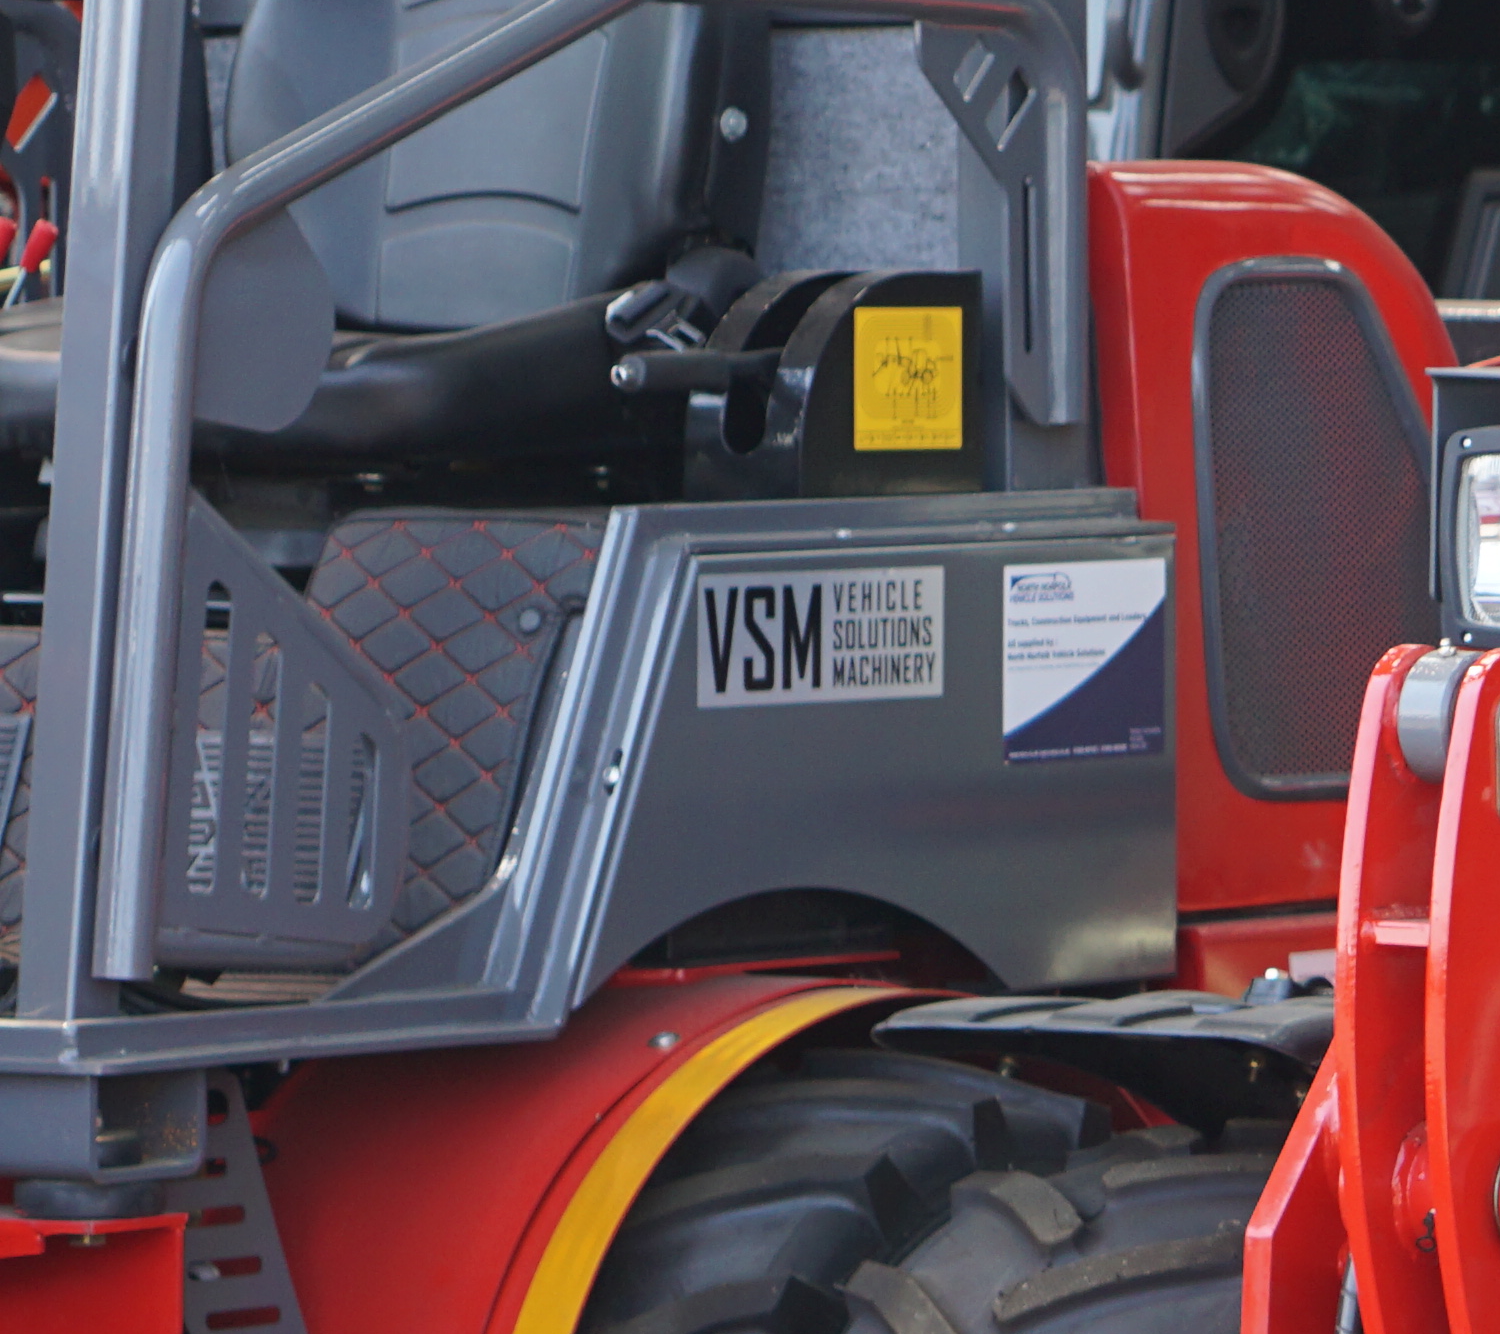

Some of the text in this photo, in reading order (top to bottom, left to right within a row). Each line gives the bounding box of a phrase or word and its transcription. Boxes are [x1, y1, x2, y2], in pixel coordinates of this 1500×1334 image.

[832, 579, 923, 612] VEHICLE
[704, 583, 823, 694] VSM
[832, 614, 934, 651] SOLUTIONS
[832, 651, 936, 688] MACHINERY
